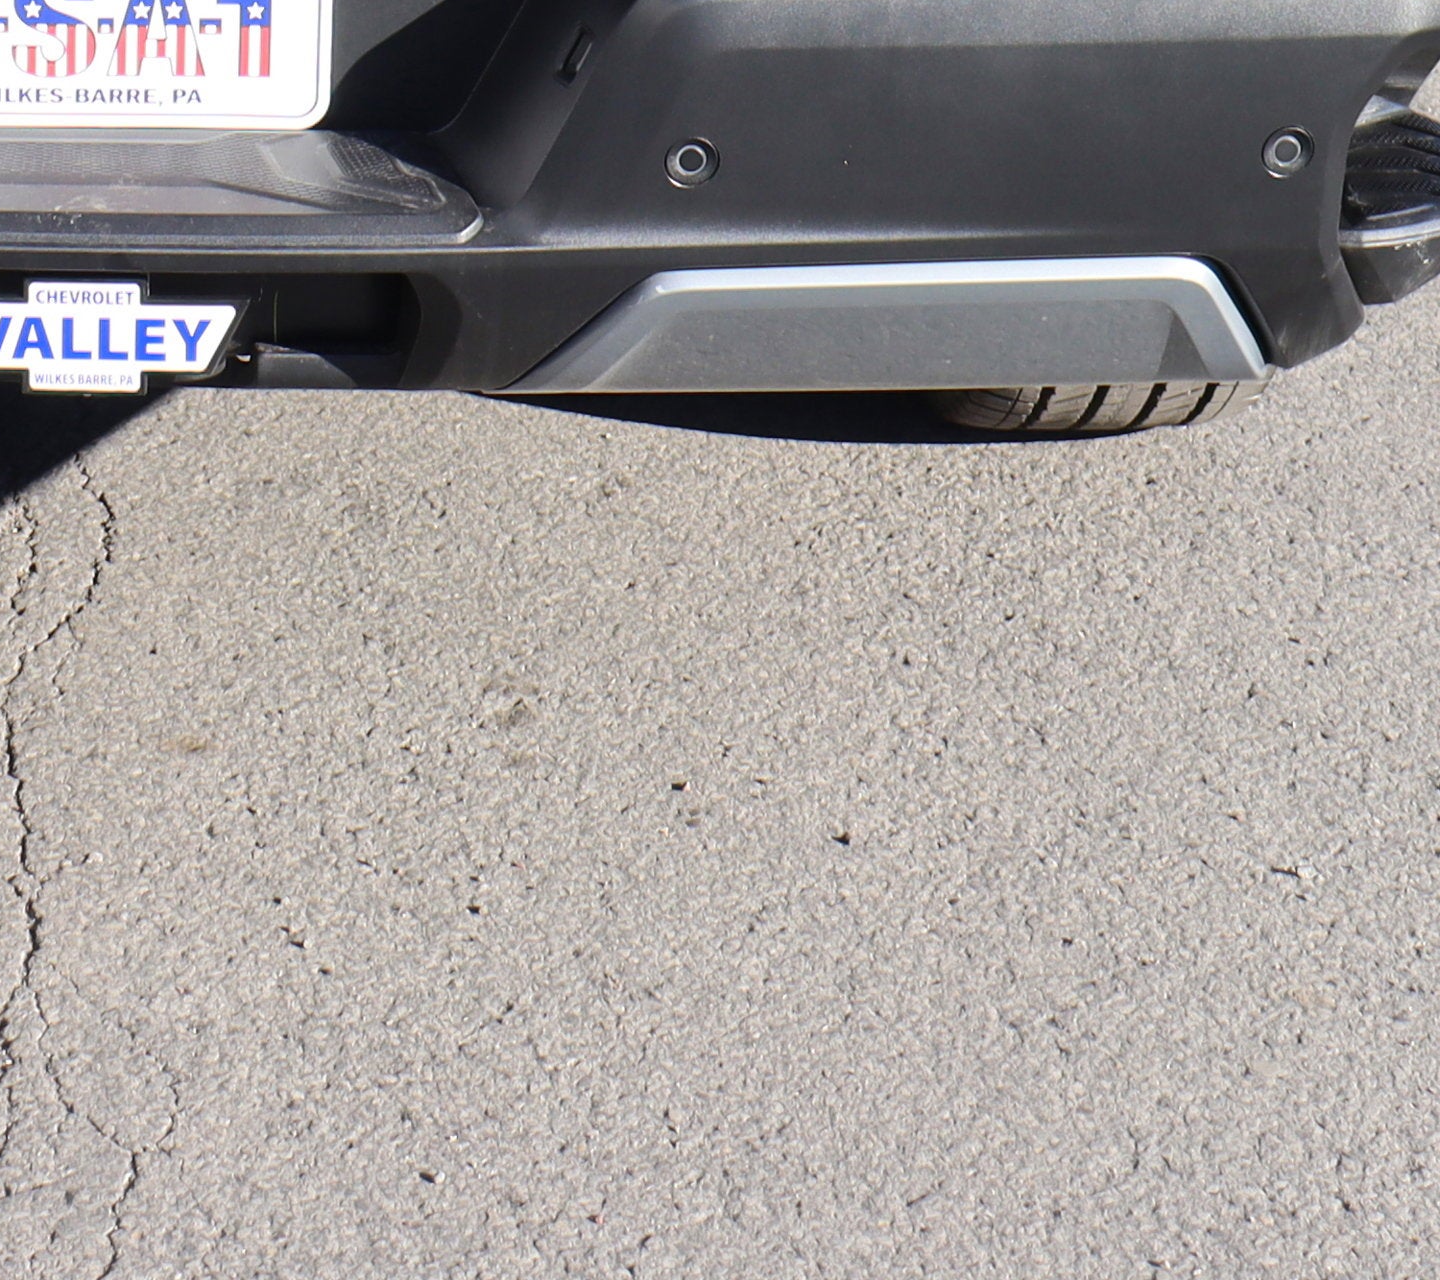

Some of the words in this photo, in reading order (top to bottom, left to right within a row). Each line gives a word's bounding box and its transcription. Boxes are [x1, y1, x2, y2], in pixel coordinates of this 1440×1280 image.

[172, 88, 203, 105] PA
[35, 289, 135, 306] CHEVROLET
[35, 372, 76, 386] WILKES
[120, 373, 134, 386] PA
